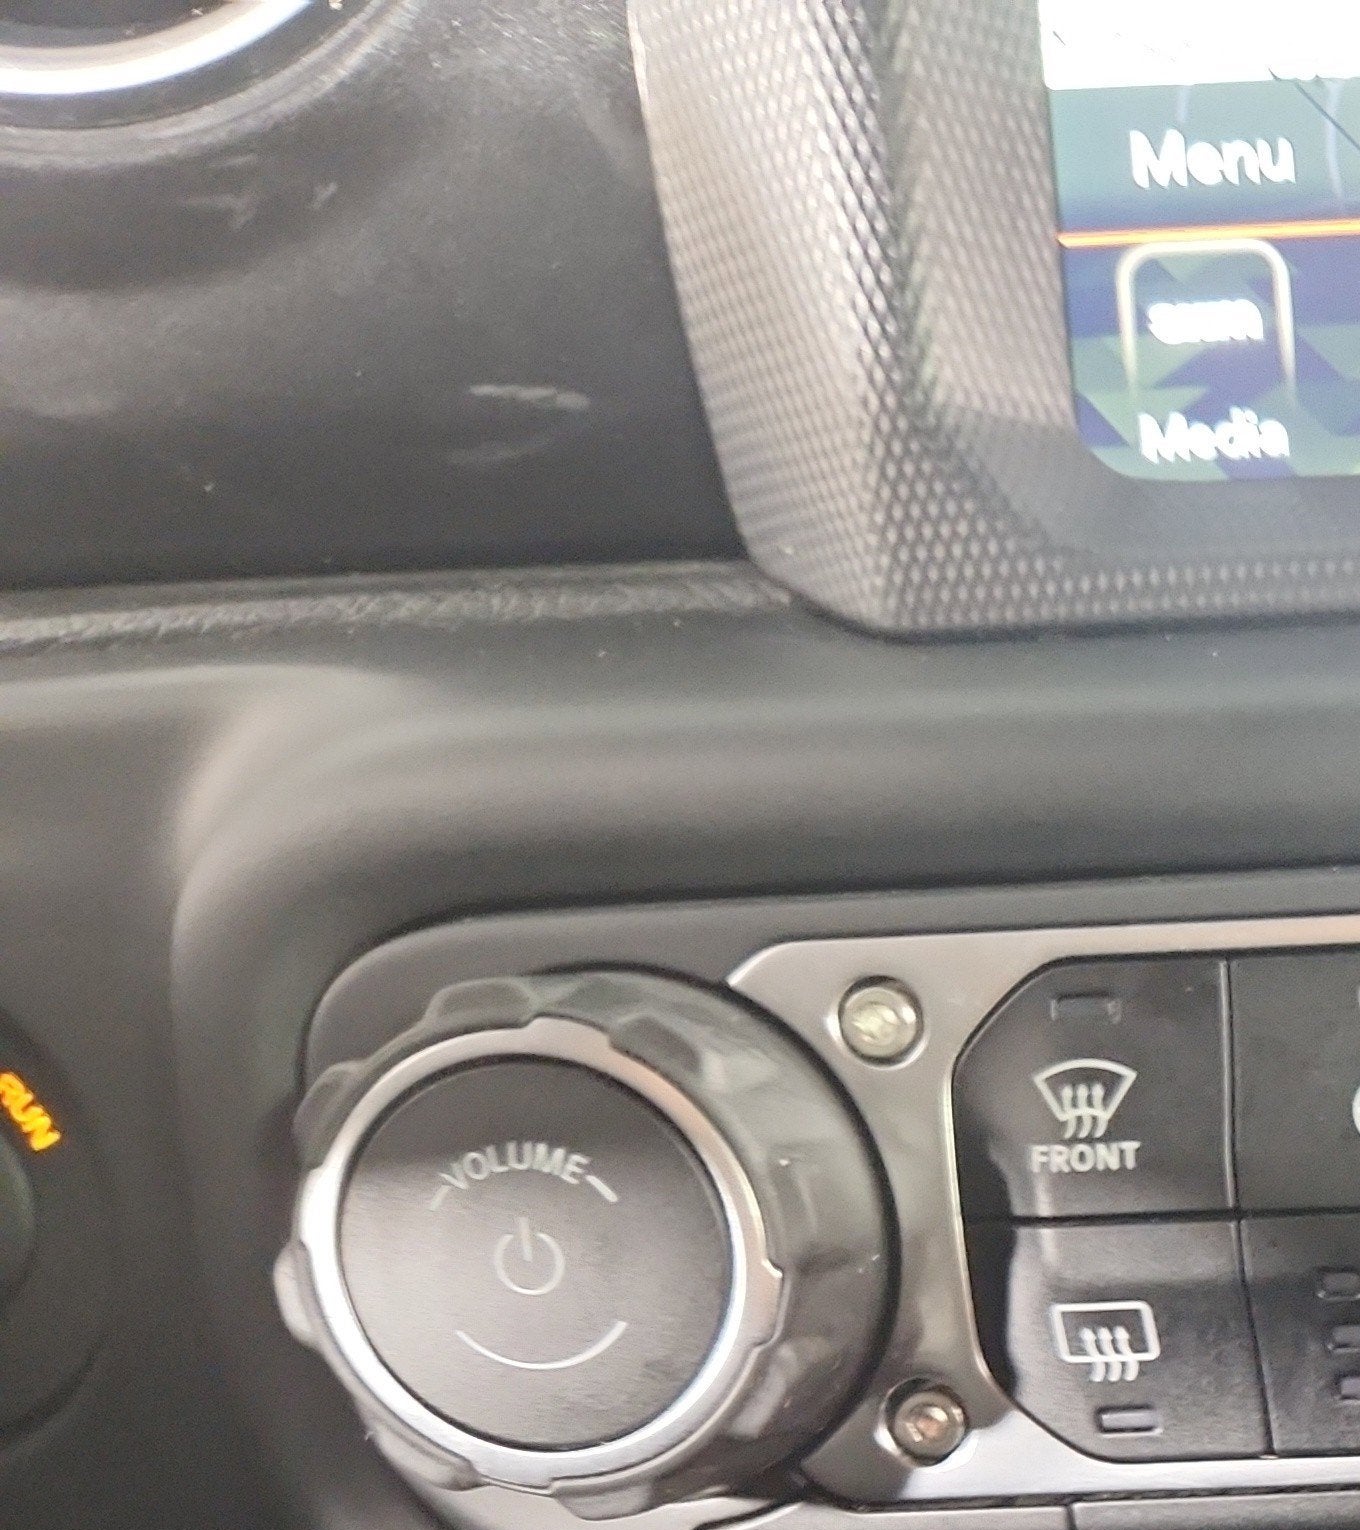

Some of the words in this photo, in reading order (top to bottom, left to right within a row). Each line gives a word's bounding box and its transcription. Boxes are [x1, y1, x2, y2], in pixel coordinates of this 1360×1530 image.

[1129, 130, 1295, 189] Menu
[1139, 406, 1289, 464] Media
[439, 1142, 592, 1187] VOLUME
[1031, 1140, 1140, 1173] FRONT
